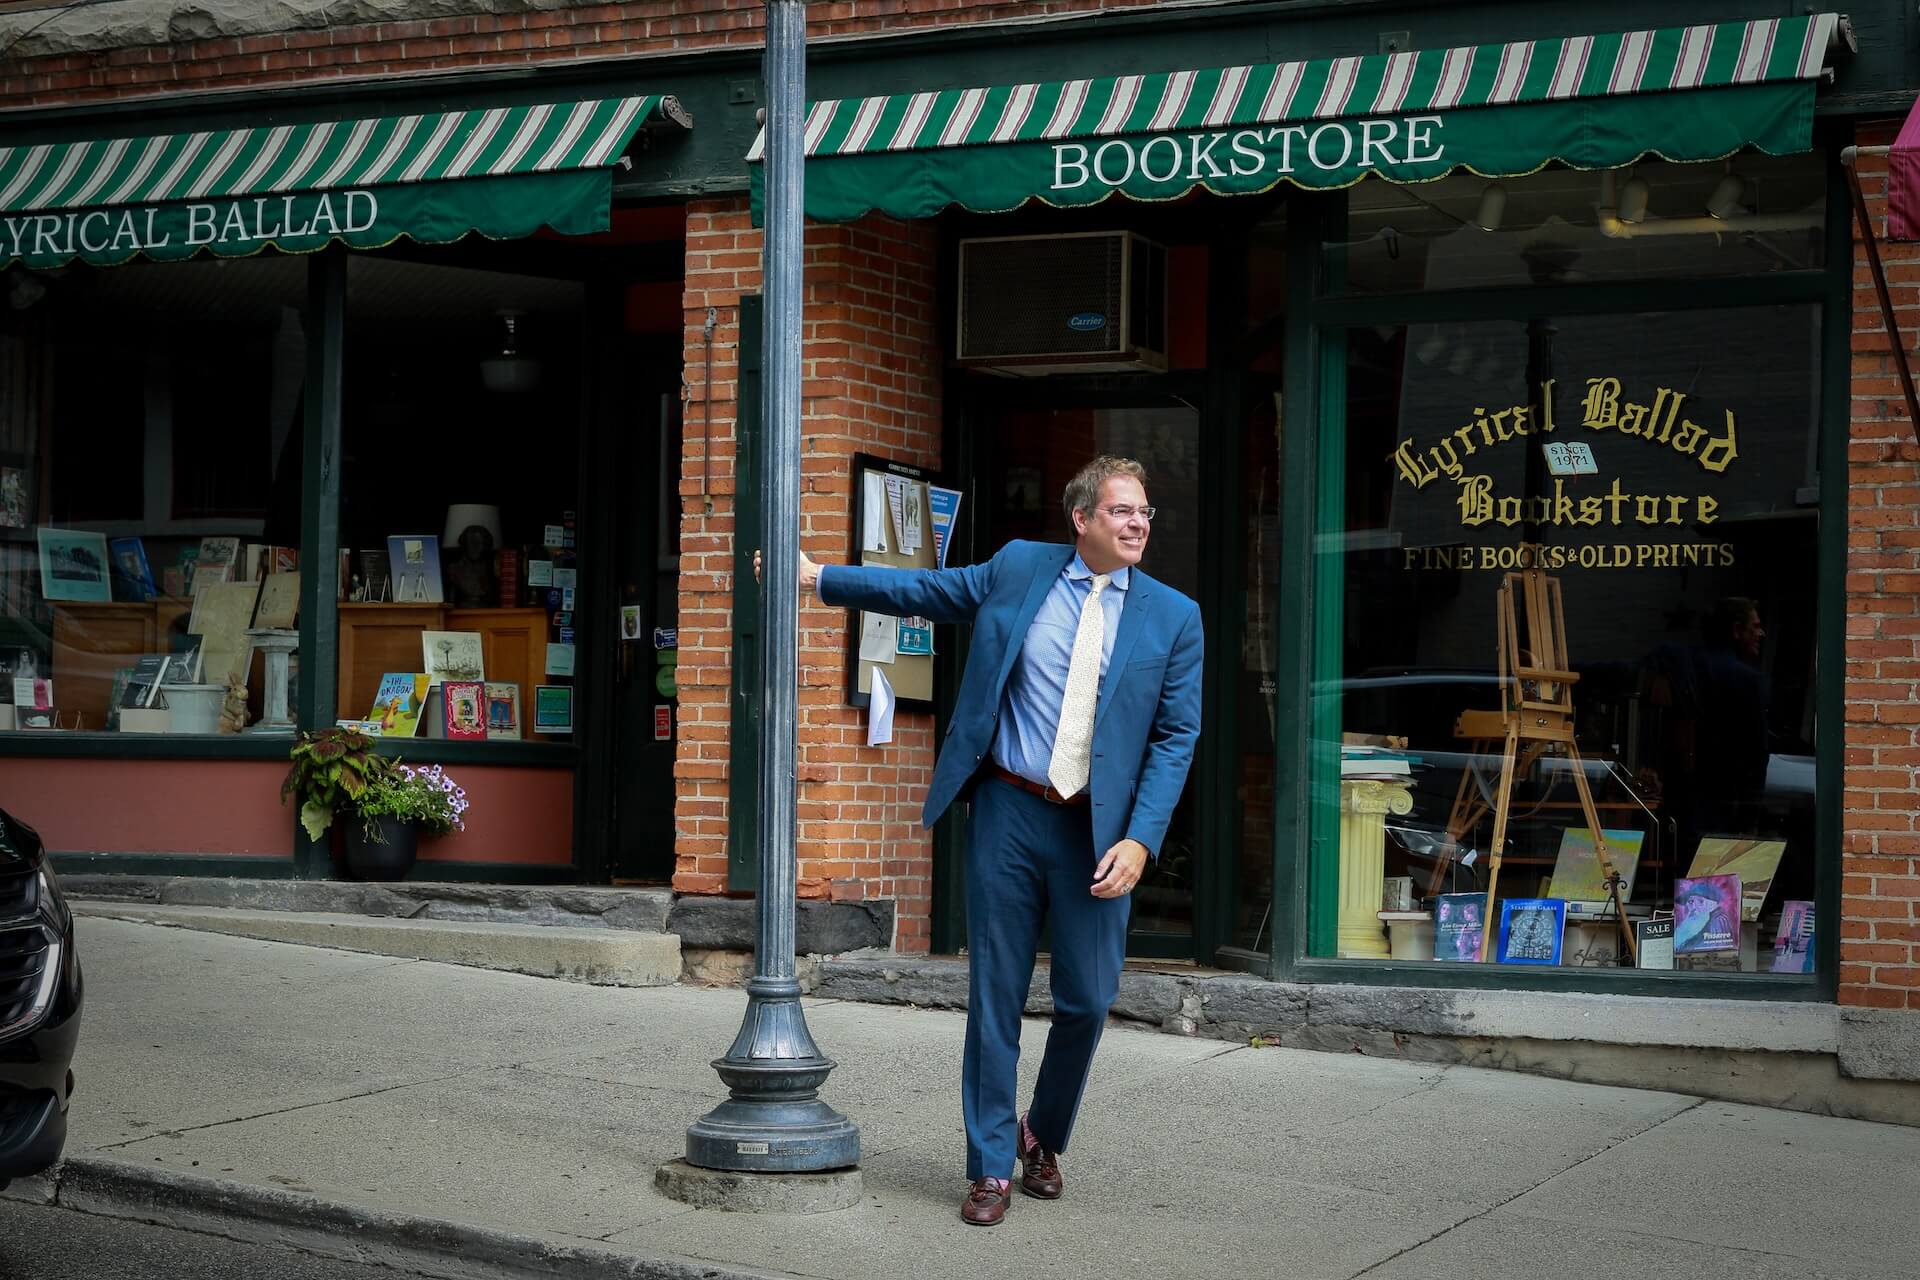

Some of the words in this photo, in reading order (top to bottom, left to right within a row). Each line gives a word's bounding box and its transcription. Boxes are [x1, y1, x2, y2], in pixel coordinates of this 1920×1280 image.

[1050, 115, 1446, 190] BOOKSTORE
[0, 208, 171, 257] YRICAL
[184, 190, 379, 246] BALLAD
[1070, 316, 1103, 326] Carrier
[1386, 378, 1557, 490] Lyrical
[1581, 376, 1740, 474] Ballad
[1550, 446, 1586, 455] SINCE
[1555, 455, 1588, 466] 1971
[1456, 474, 1720, 527] Bookstore
[1403, 547, 1474, 570] FINE
[1579, 544, 1632, 568] OLD
[1636, 543, 1736, 568] PRINTS
[381, 685, 412, 697] DRAGON
[1646, 923, 1671, 935] SALE
